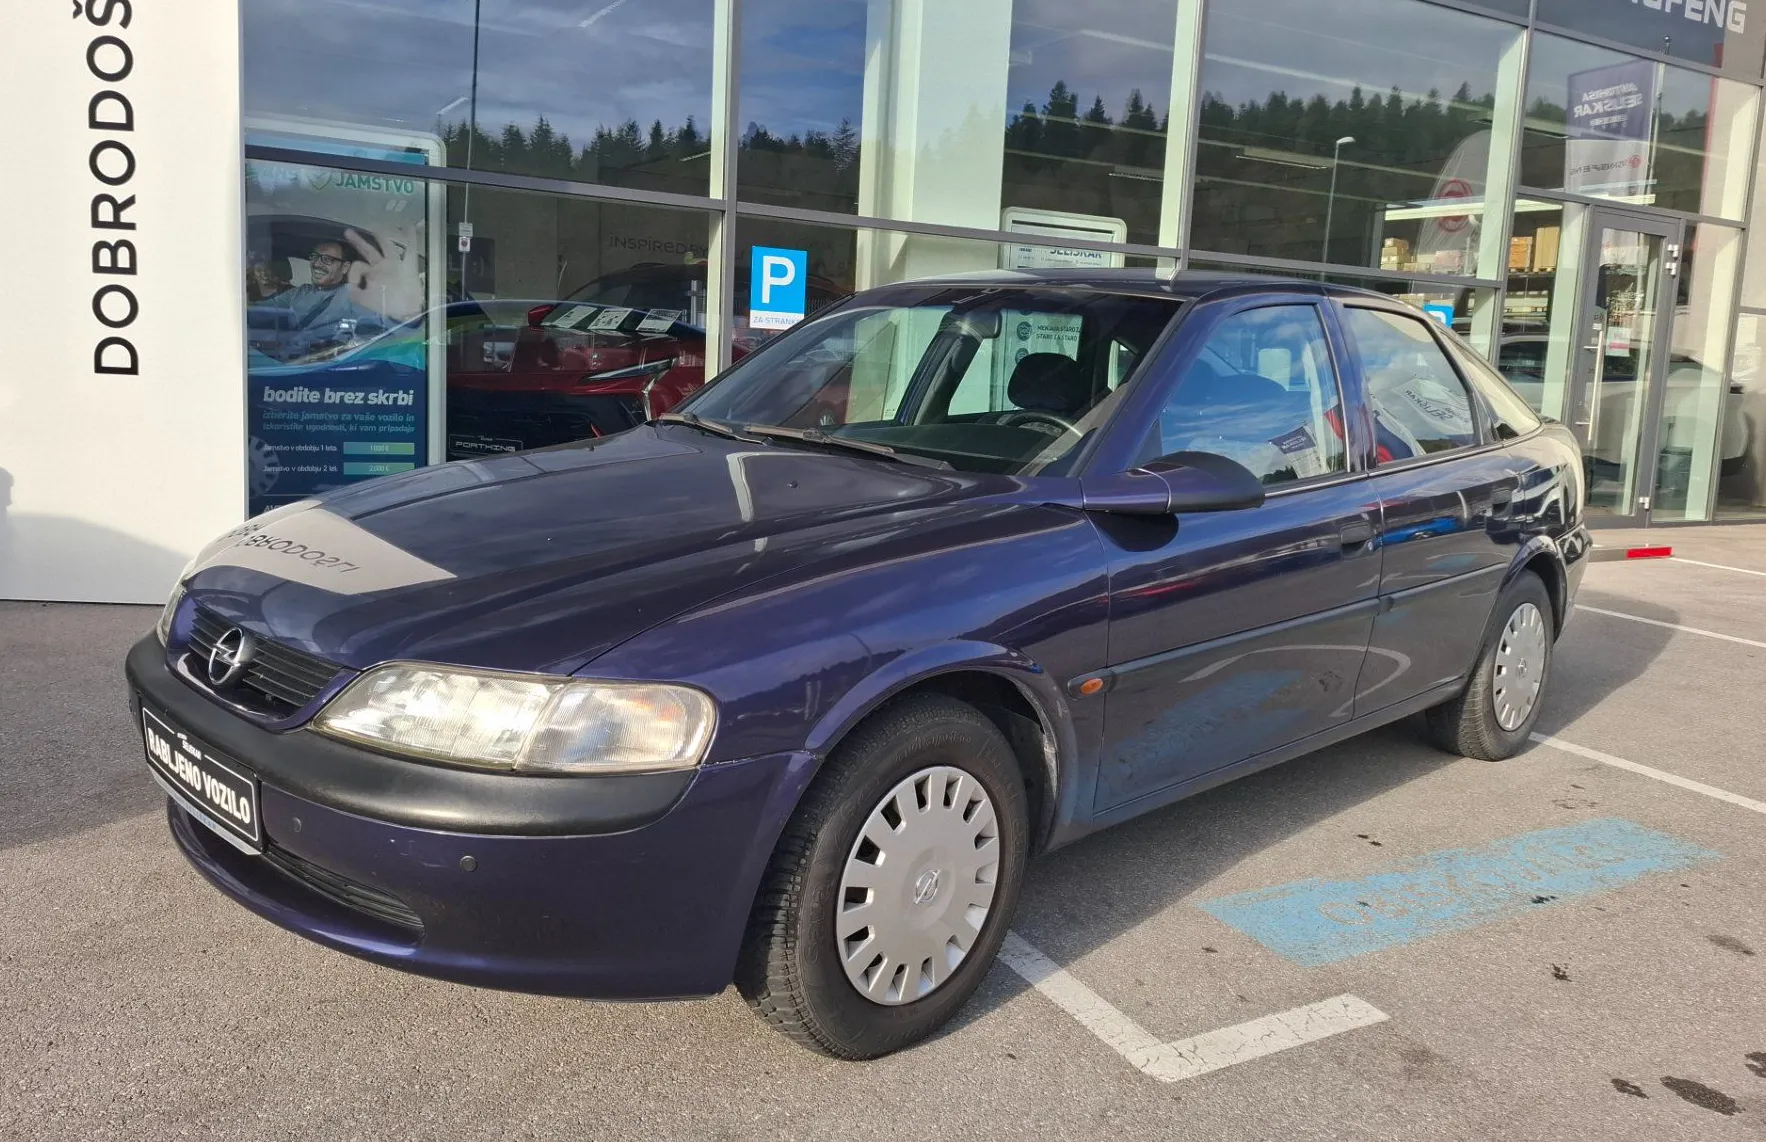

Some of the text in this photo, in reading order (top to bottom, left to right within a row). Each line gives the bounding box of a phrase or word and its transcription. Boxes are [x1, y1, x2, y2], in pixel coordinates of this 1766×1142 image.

[335, 172, 415, 194] JAMSTVO
[762, 255, 796, 304] P
[753, 316, 801, 326] ZA STRANK
[263, 386, 415, 406] bodite brez skrbi
[263, 411, 415, 422] izberite jamstvo za vaše vozilo in
[349, 423, 357, 432] ki
[360, 425, 377, 433] vam
[378, 424, 415, 434] pripadajo
[147, 727, 202, 791] RABLJENO
[202, 771, 250, 824] VOZILO
